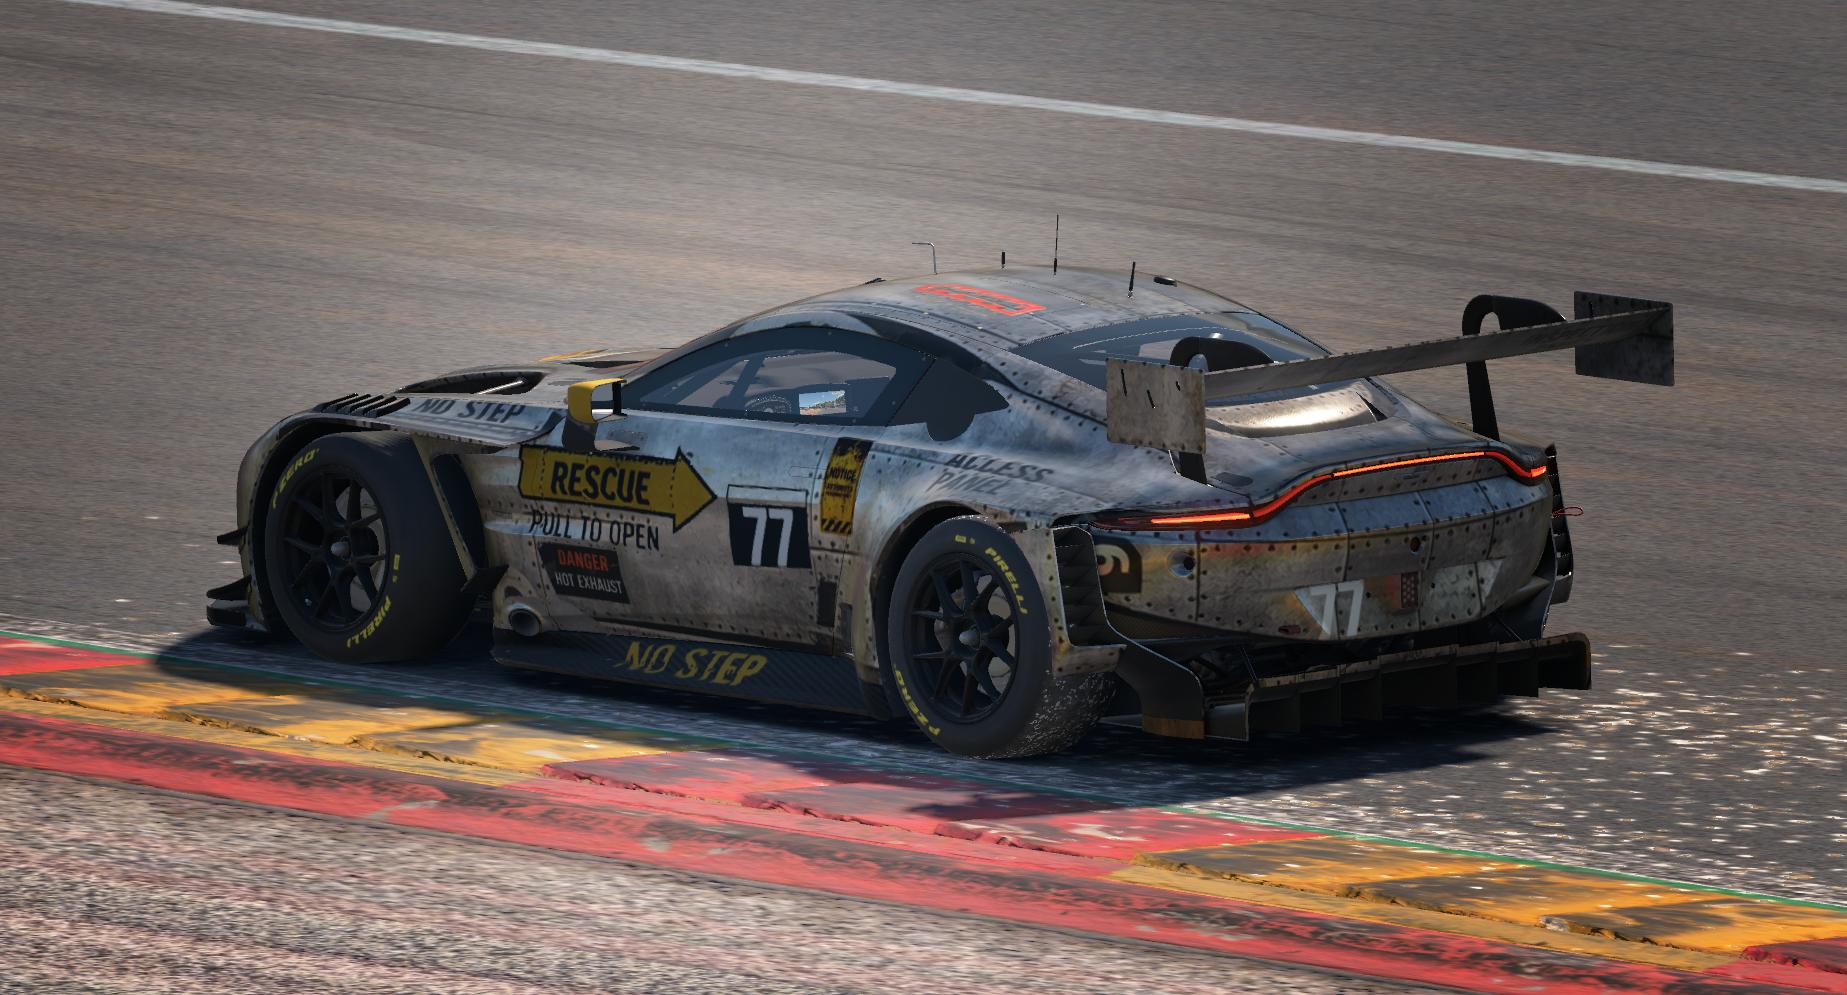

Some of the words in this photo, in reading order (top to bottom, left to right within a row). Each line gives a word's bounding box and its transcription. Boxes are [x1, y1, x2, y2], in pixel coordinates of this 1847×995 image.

[412, 399, 456, 415] NO
[457, 400, 526, 423] STEP
[551, 461, 651, 505] RESCUE
[926, 472, 1010, 495] PANEL
[944, 453, 1054, 482] ACCESS
[529, 507, 572, 539] PULL
[581, 515, 602, 542] TO
[609, 520, 660, 551] OPEN
[742, 506, 794, 568] 77
[557, 549, 609, 571] DANGER
[984, 547, 1028, 614] PIRELLI
[555, 572, 575, 587] HOT
[577, 575, 623, 594] EXHAUST
[347, 595, 391, 648] PIRELLI
[1309, 579, 1365, 638] 77
[624, 641, 677, 674] NO
[674, 648, 768, 686] STEP
